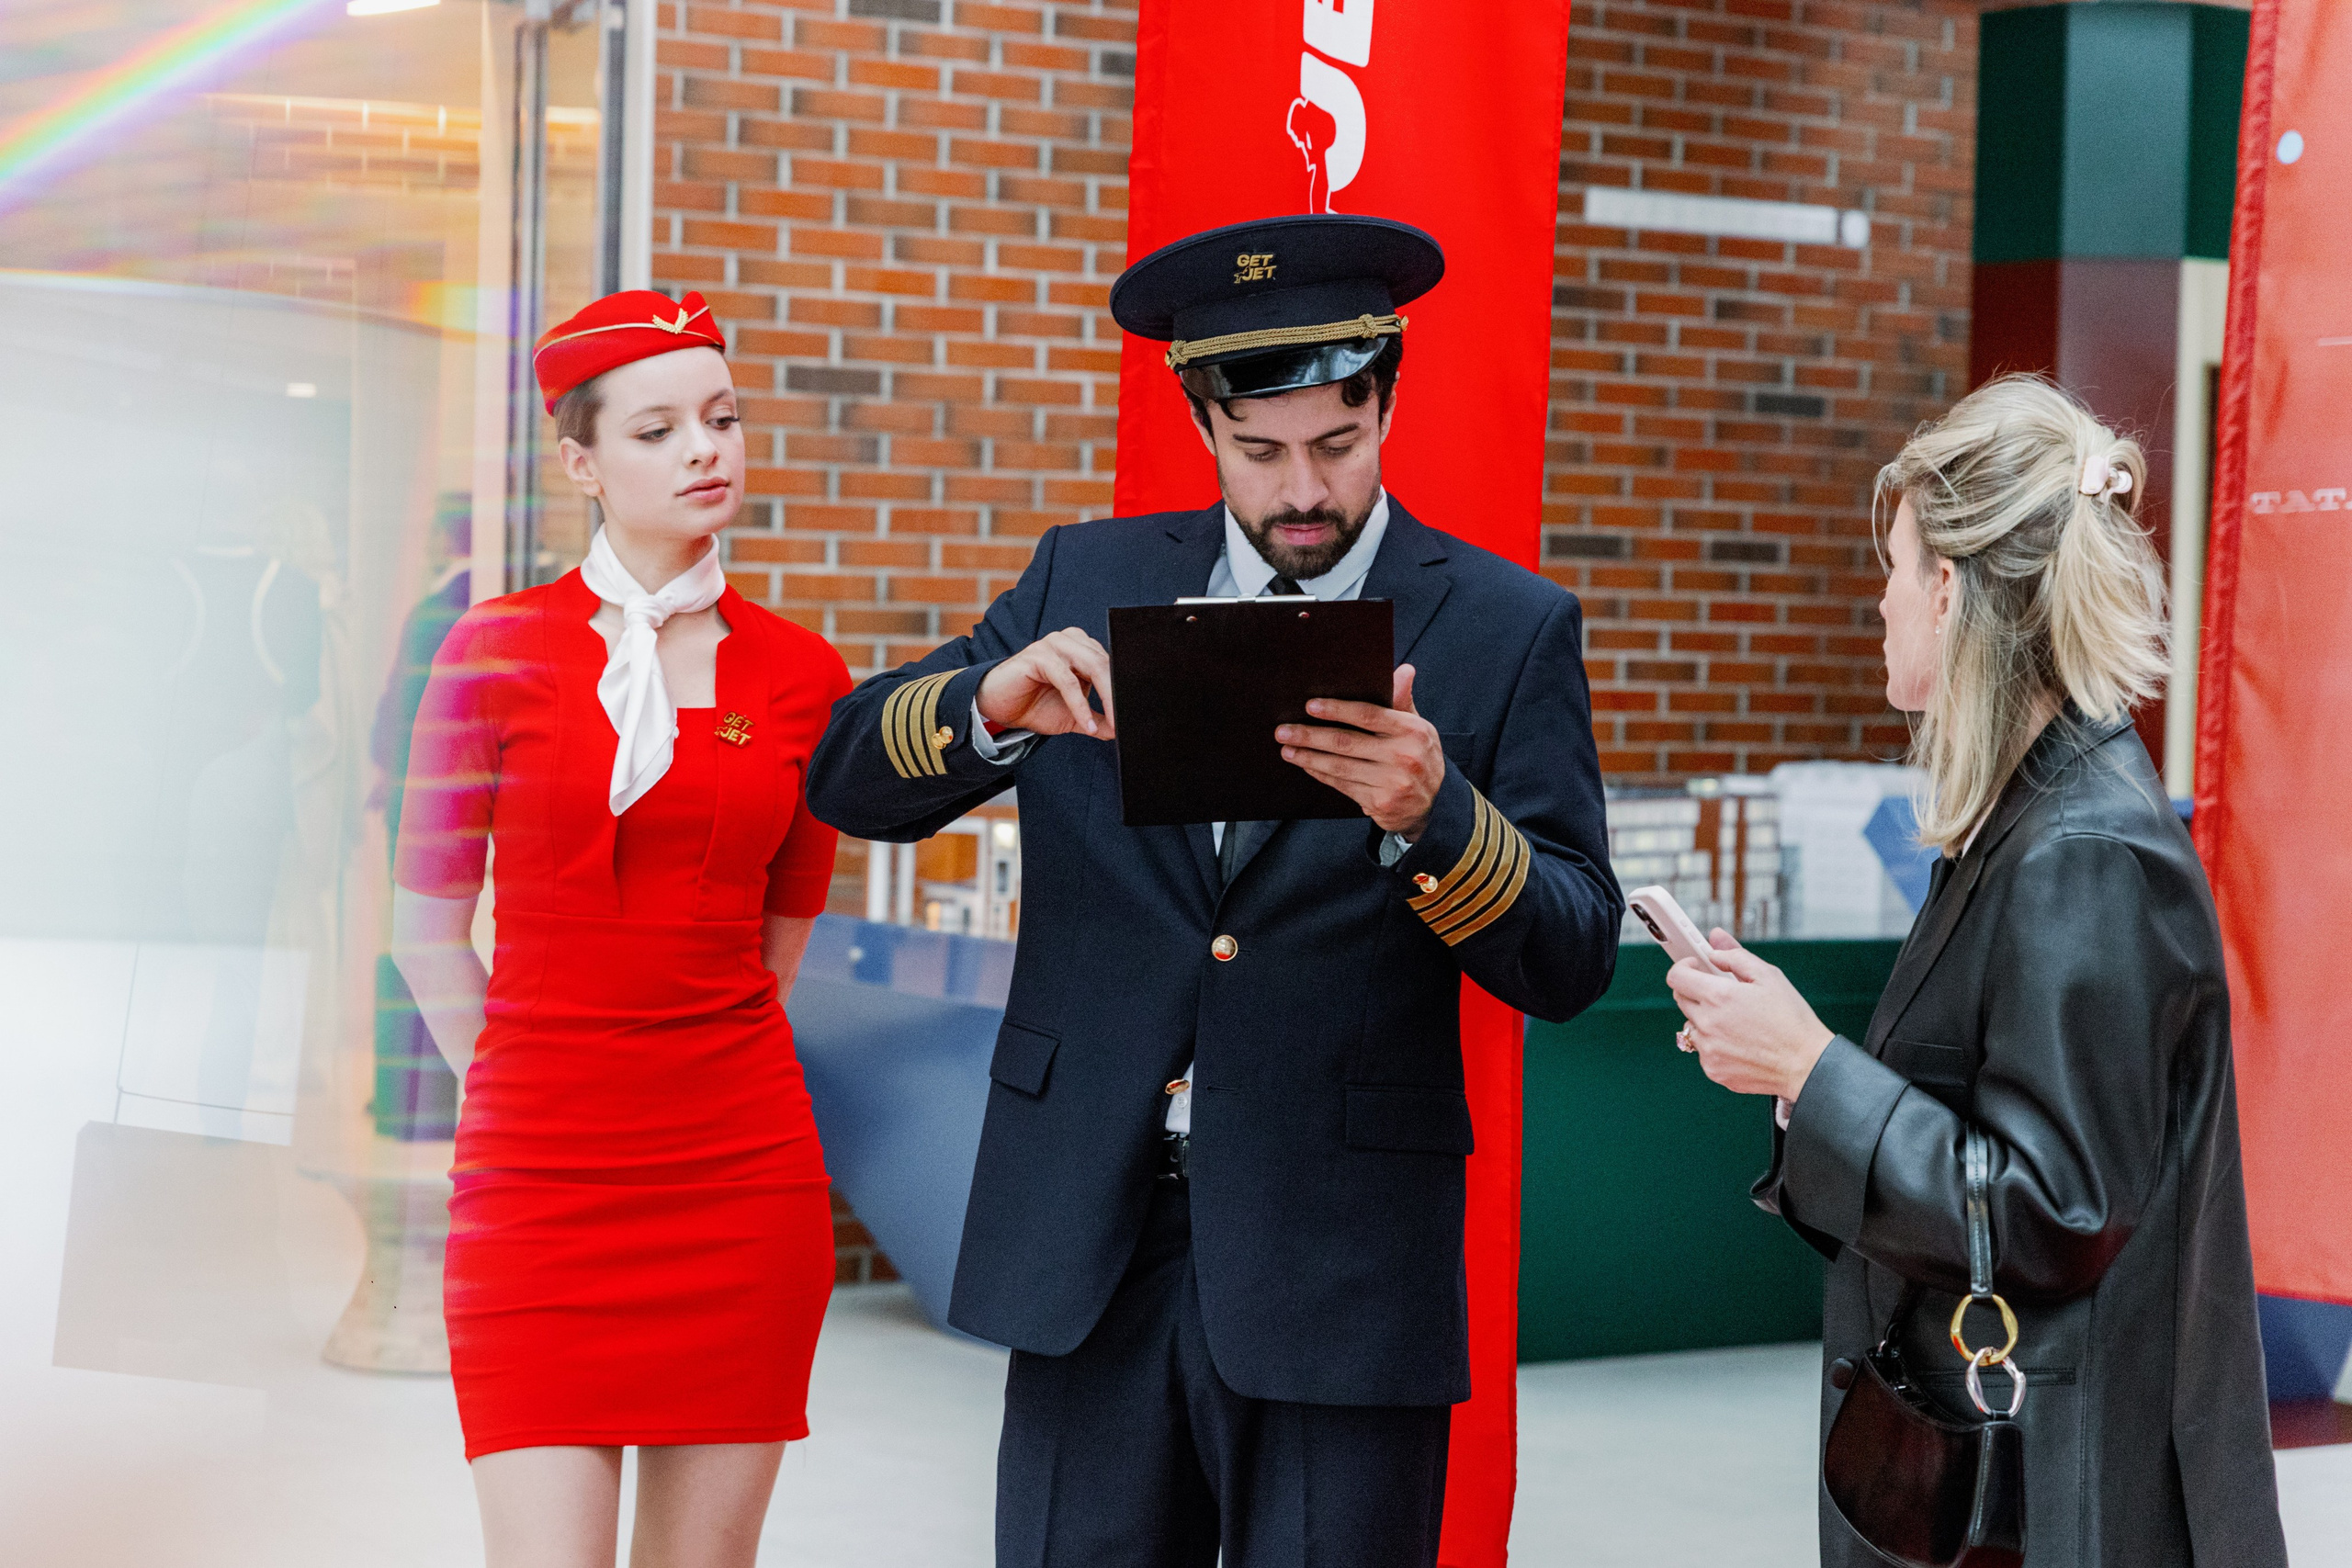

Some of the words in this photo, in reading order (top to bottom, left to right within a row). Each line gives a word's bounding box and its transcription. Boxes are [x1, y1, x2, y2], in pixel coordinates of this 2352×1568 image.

[1237, 254, 1274, 267] GET
[1241, 265, 1277, 281] JET
[2250, 487, 2352, 514] TAT
[723, 711, 754, 731] GET
[719, 727, 752, 745] JET
